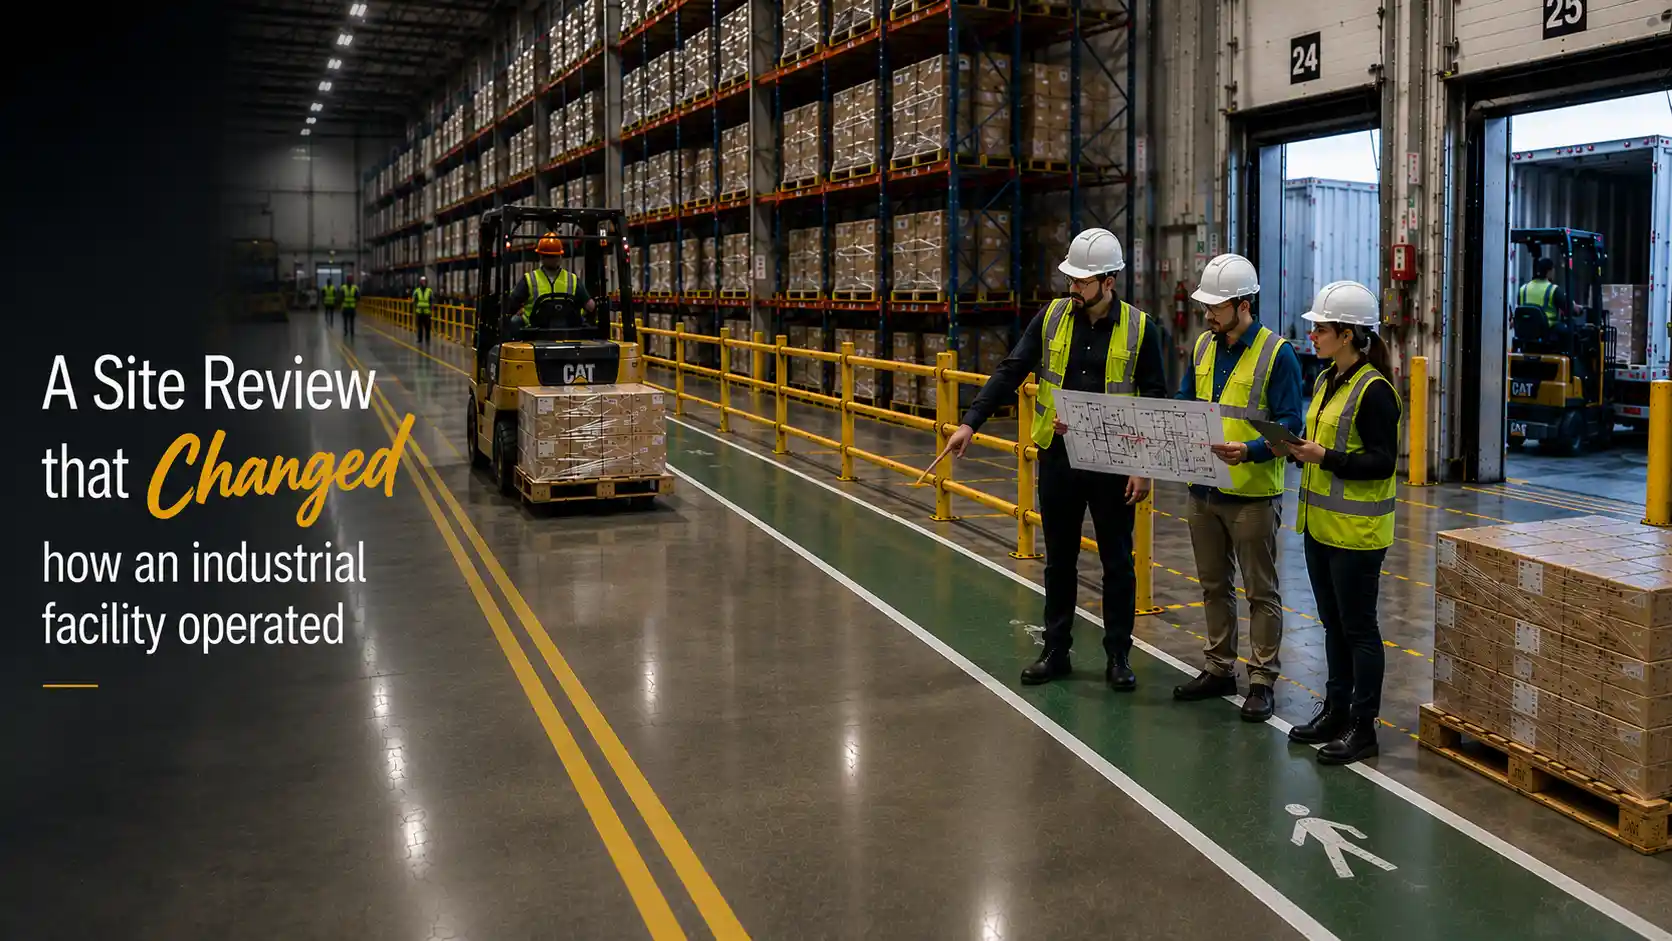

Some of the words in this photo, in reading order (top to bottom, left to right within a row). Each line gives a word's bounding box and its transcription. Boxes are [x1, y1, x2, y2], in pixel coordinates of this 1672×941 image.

[1546, 0, 1583, 29] 25
[1292, 42, 1318, 76] 24
[563, 363, 596, 384] CAT
[1512, 381, 1533, 397] CAT
